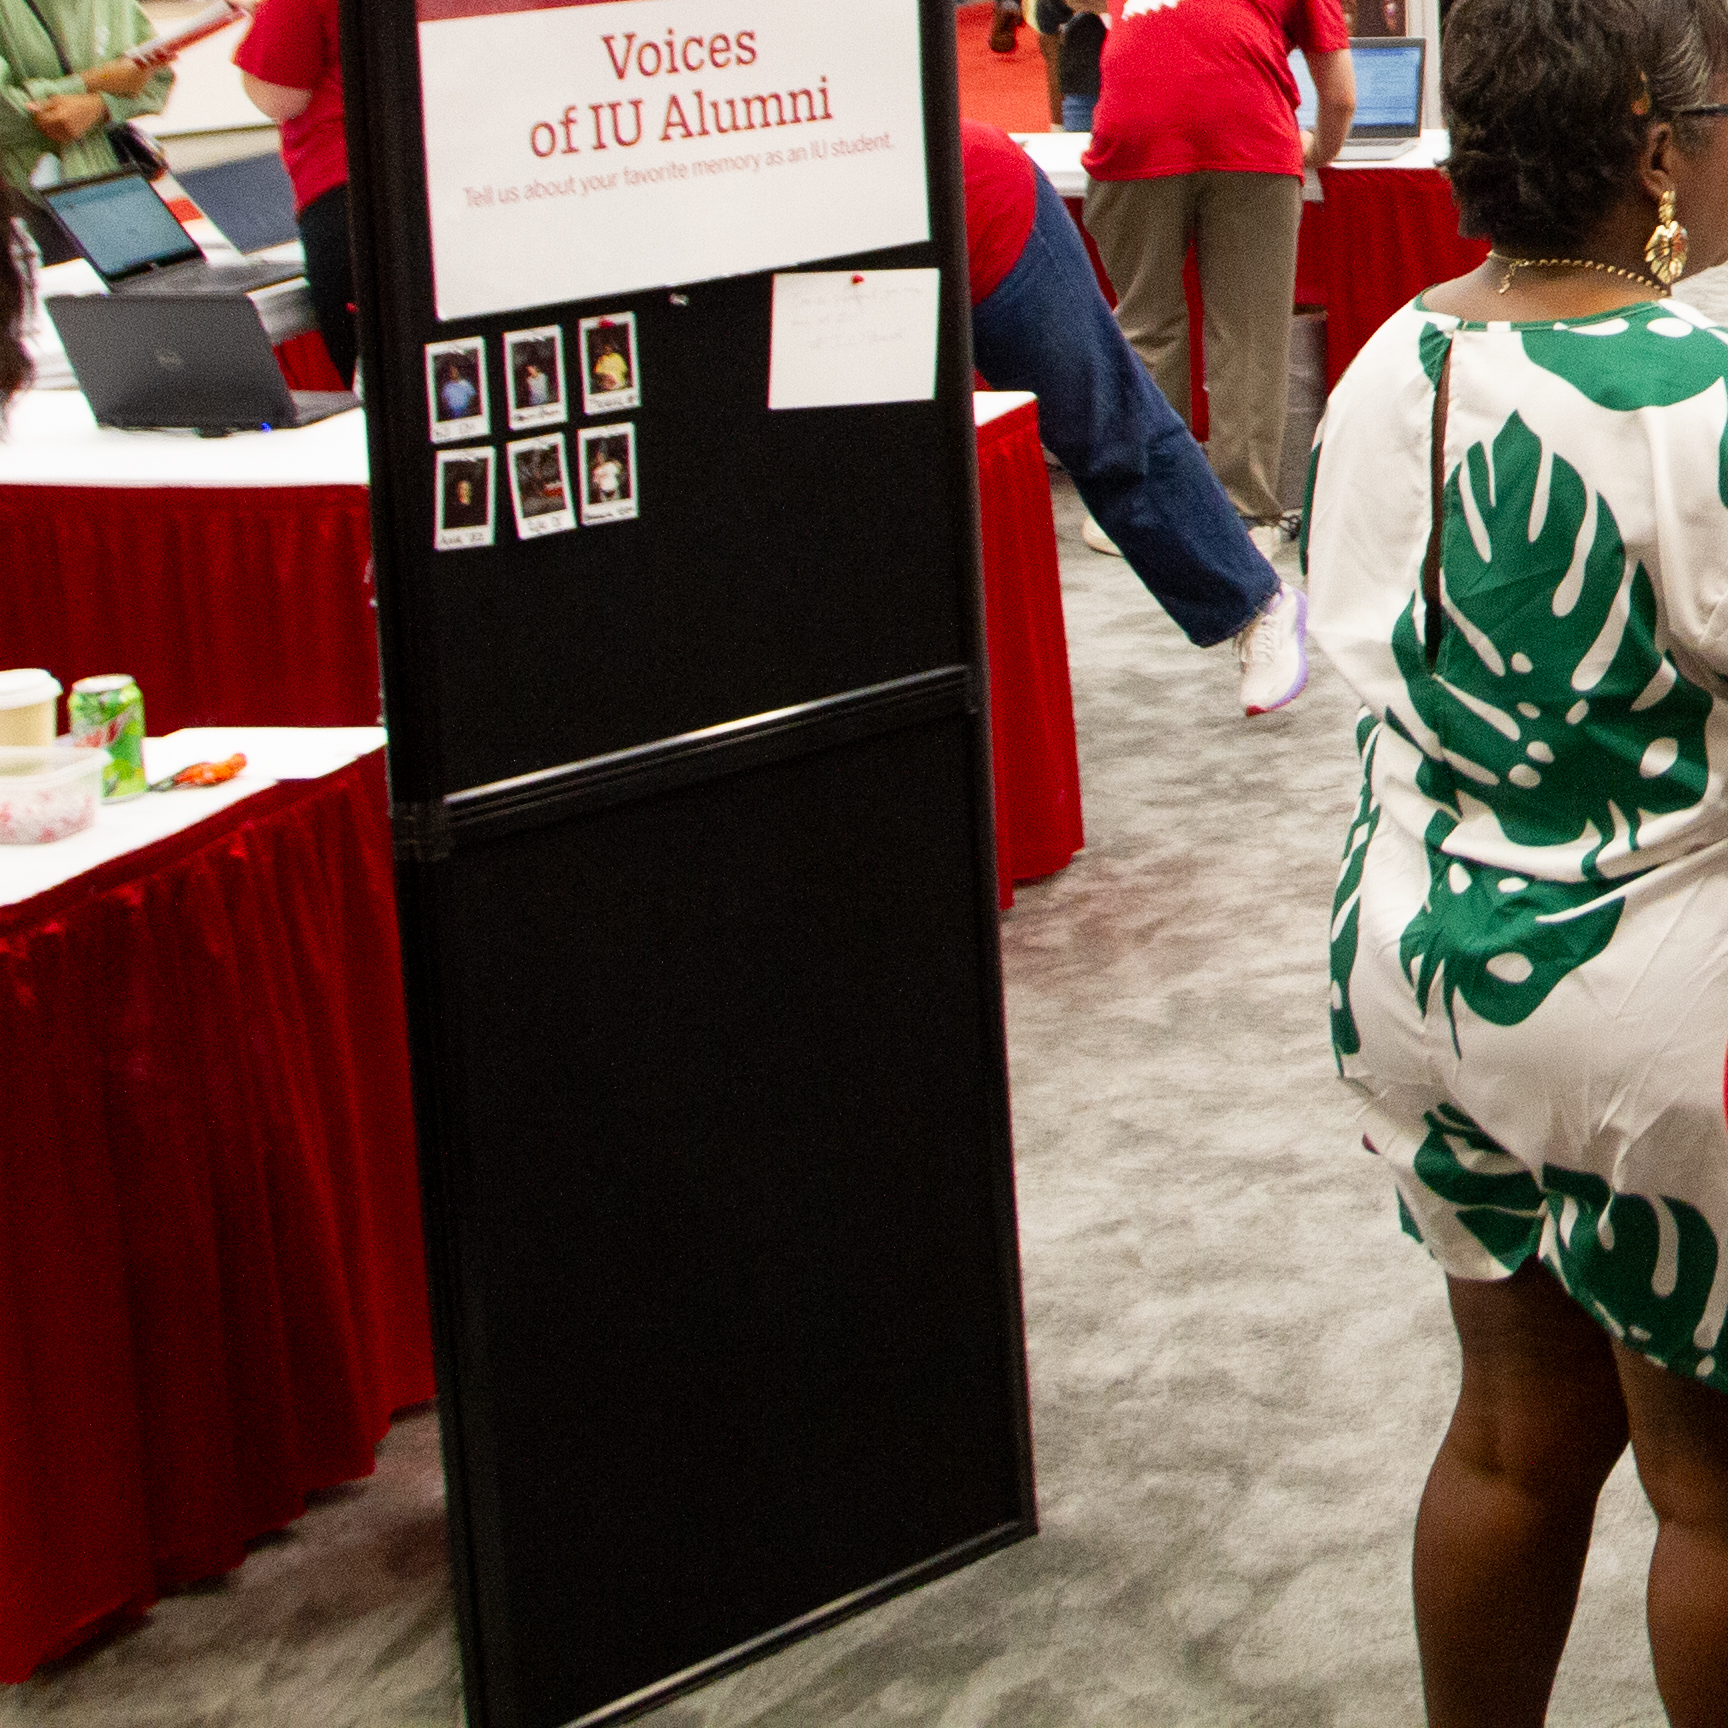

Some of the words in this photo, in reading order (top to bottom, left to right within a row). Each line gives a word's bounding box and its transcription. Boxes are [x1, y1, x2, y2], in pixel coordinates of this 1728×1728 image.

[602, 28, 758, 82] Voices
[530, 108, 580, 158] of
[590, 97, 646, 152] IU
[659, 77, 834, 142] Alumni
[463, 184, 494, 208] Tell
[499, 184, 520, 204] us
[524, 175, 577, 200] about
[580, 172, 619, 194] your
[623, 161, 690, 186] favorite
[692, 152, 762, 177] memory
[763, 150, 785, 167] as
[786, 144, 809, 164] an
[811, 138, 828, 160] IU
